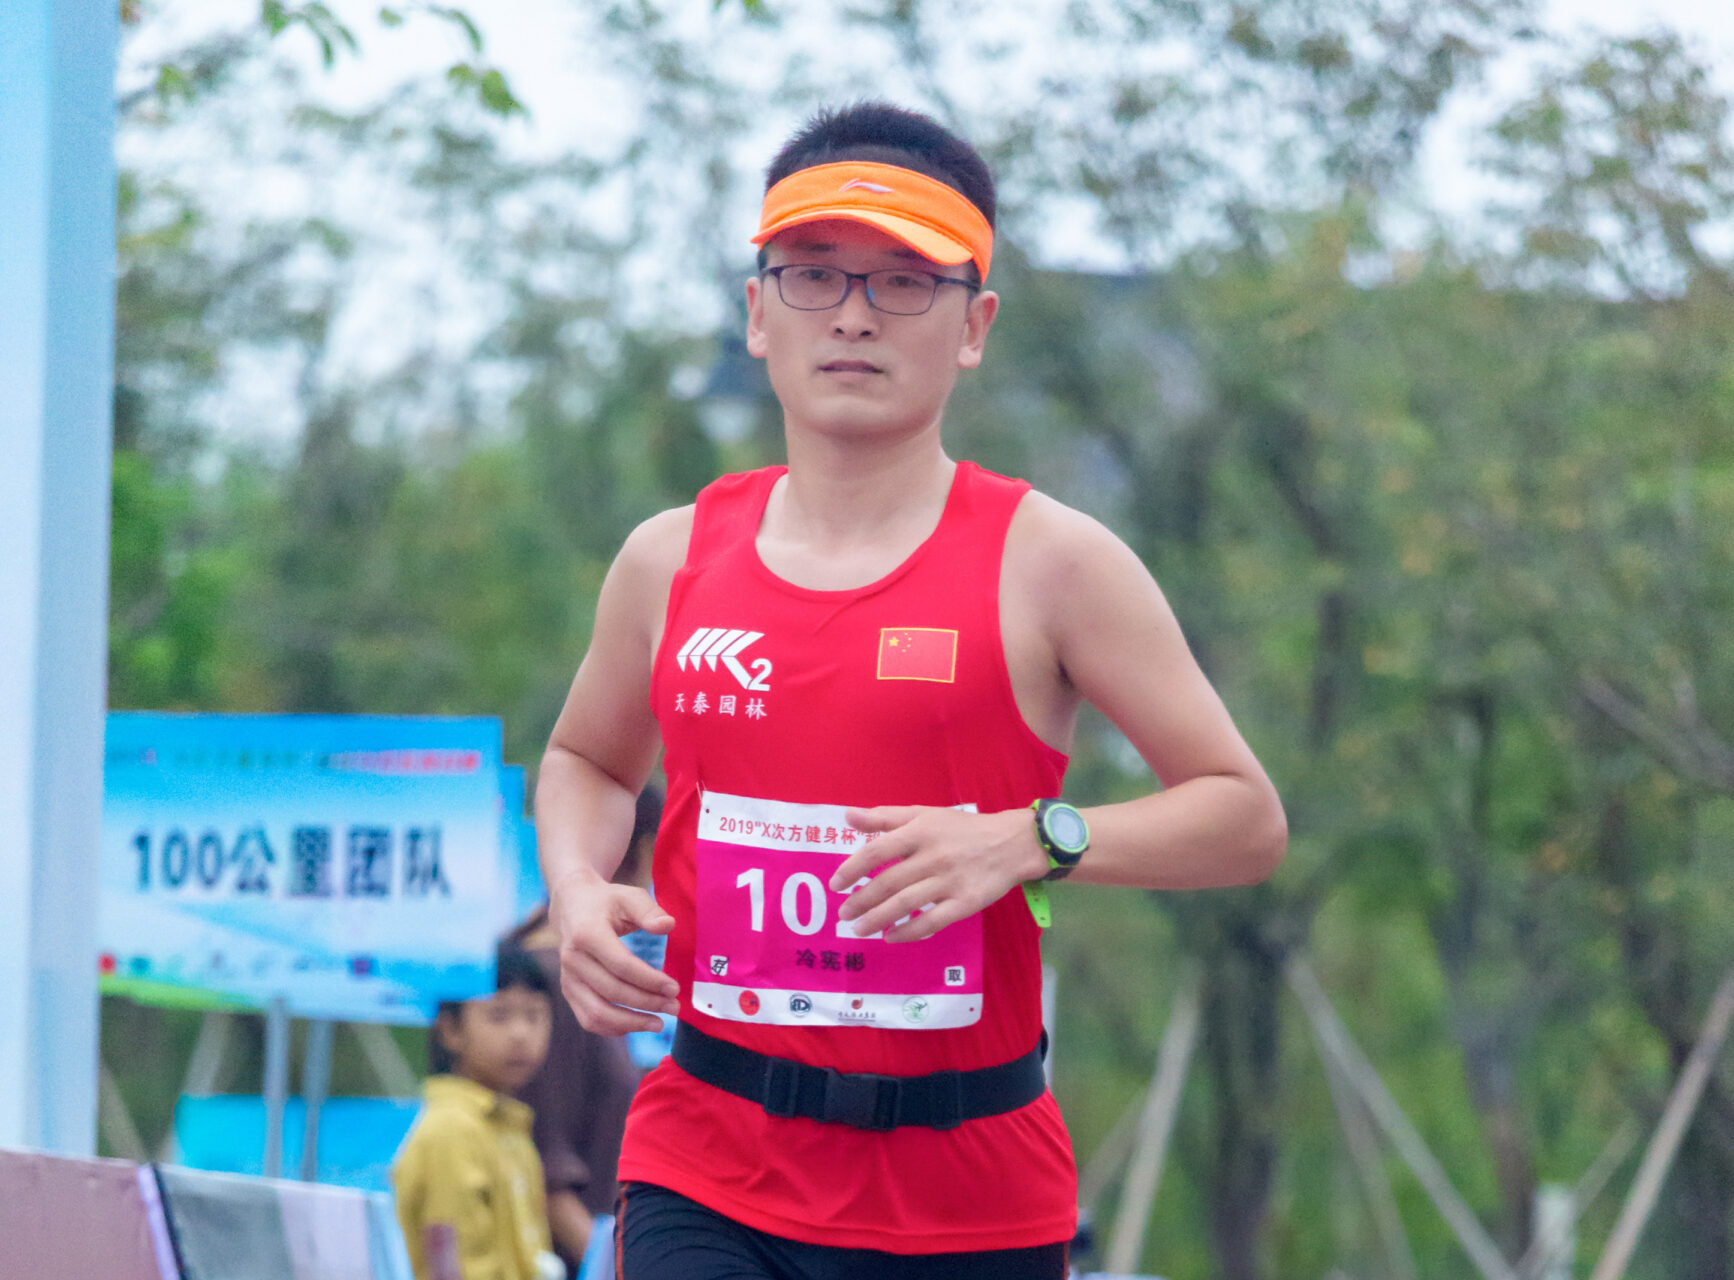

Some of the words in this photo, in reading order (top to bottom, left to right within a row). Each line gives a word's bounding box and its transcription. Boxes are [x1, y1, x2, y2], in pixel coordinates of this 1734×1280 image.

[674, 691, 768, 720] 天泰园林
[133, 820, 453, 900] 100公里团队
[736, 867, 937, 939] 102
[948, 968, 962, 982] 取
